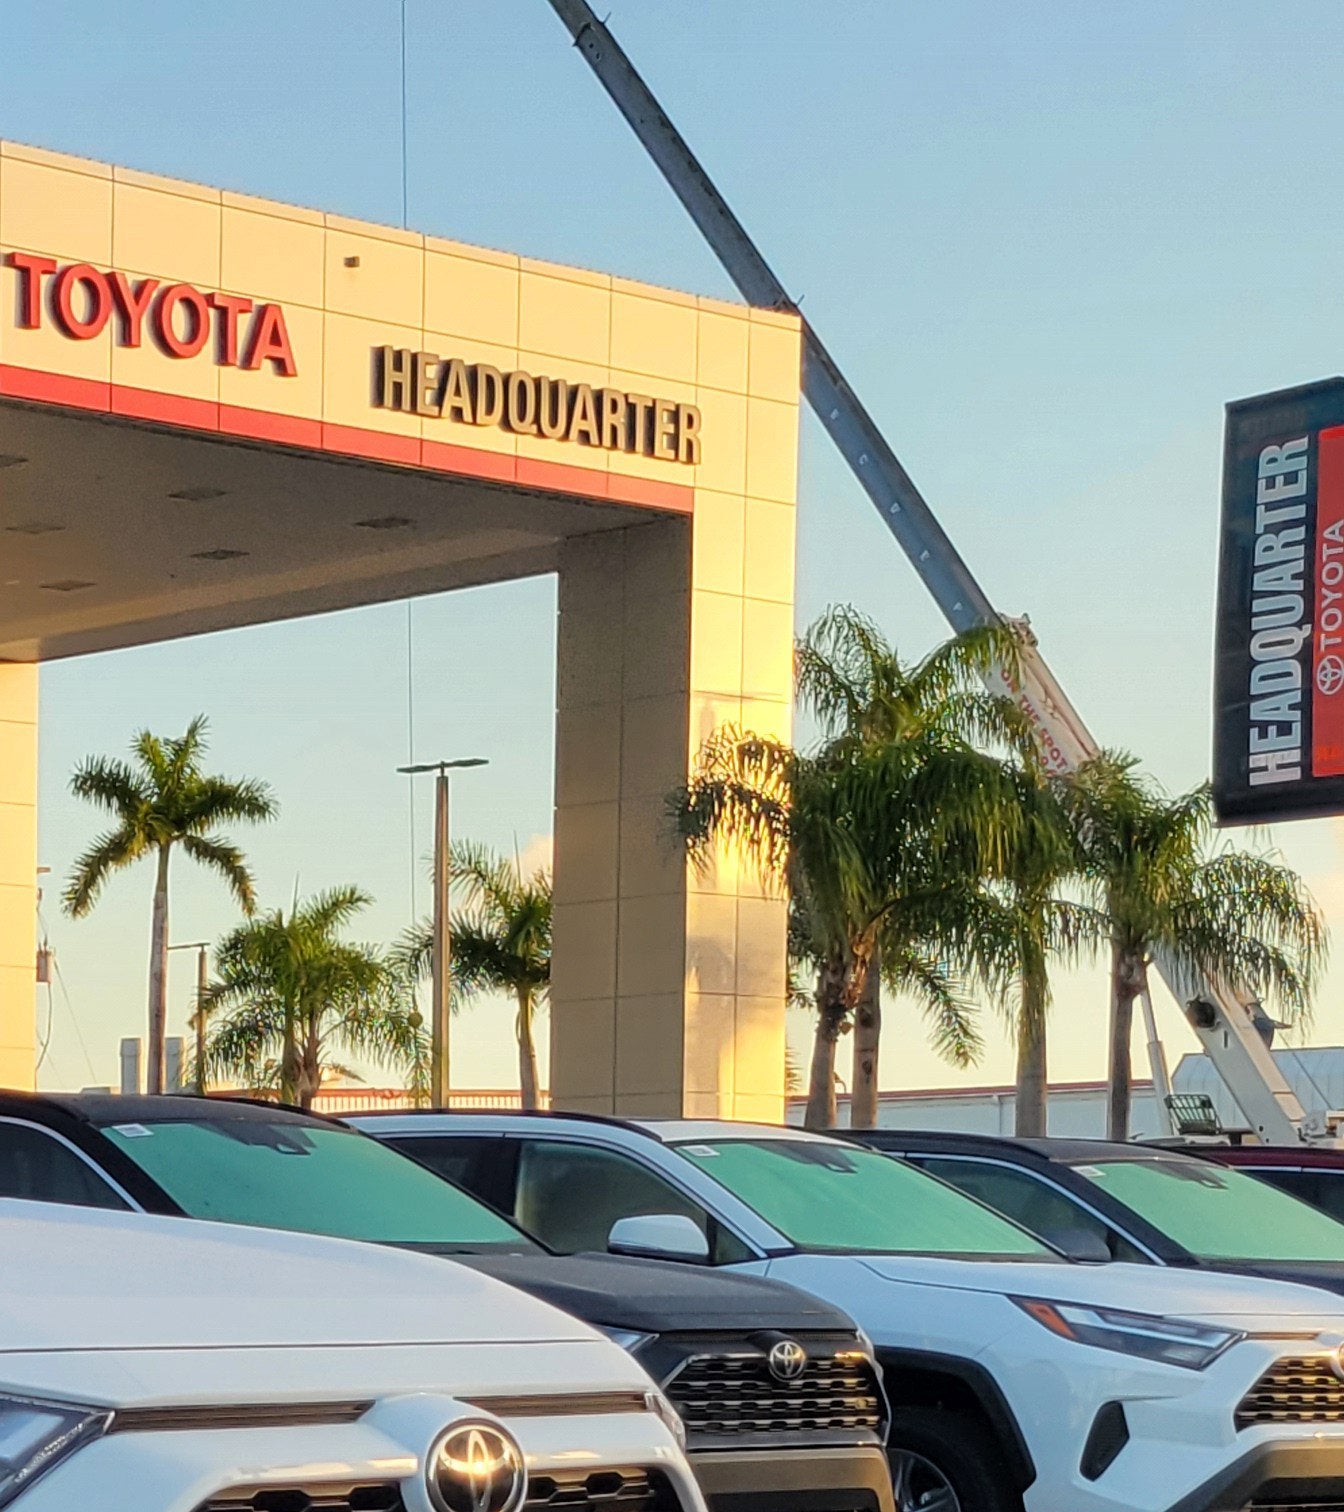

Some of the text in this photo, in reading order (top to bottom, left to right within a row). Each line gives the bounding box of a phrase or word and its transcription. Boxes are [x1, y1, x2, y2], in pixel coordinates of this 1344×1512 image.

[3, 251, 299, 378] TOYOTA
[372, 344, 703, 466] HEADQUARTER
[1248, 434, 1312, 787] HEADQUARTER
[1319, 519, 1344, 653] TOYOTA
[1038, 728, 1069, 770] SPOT
